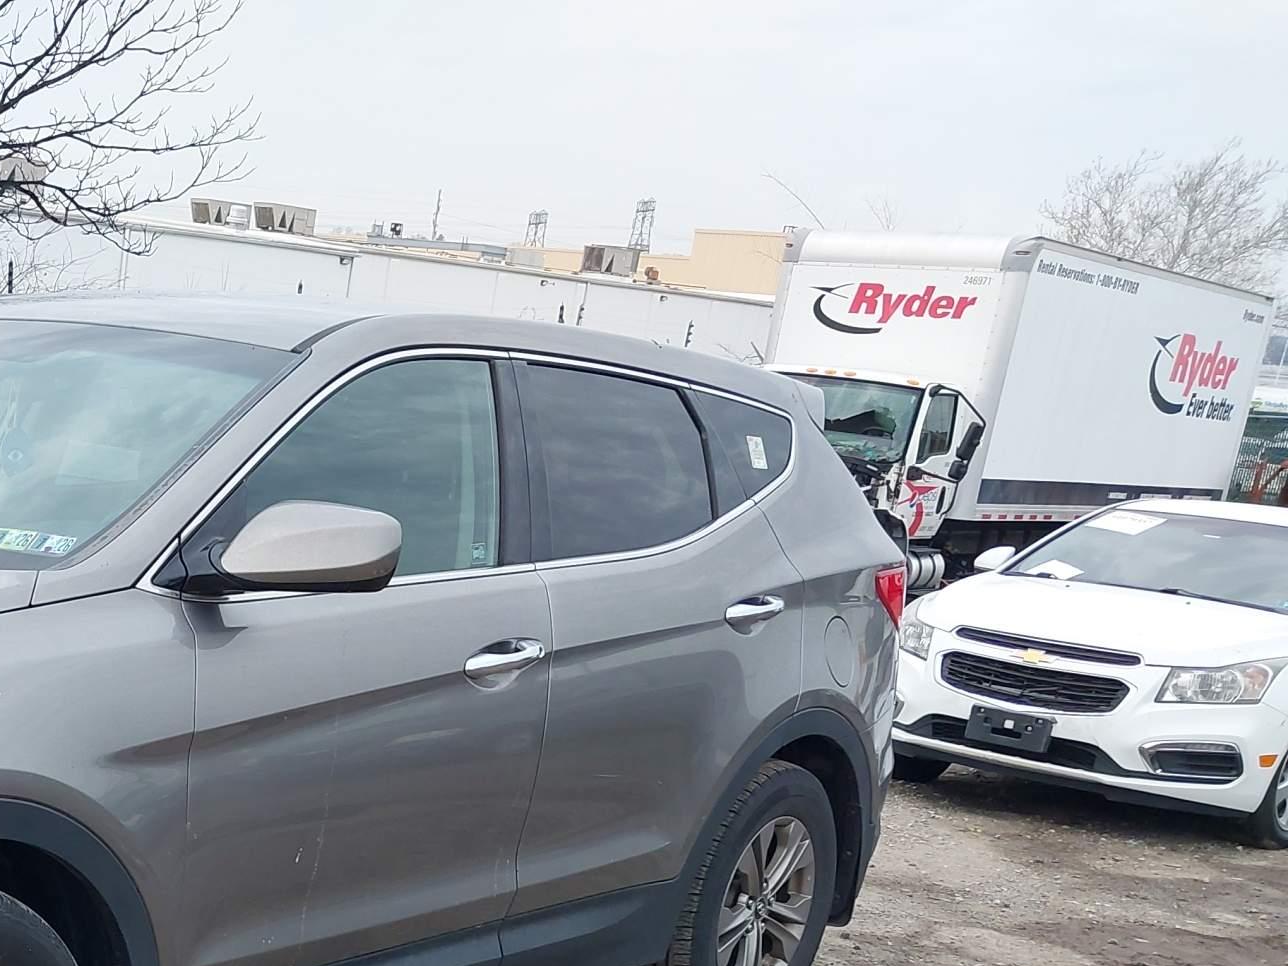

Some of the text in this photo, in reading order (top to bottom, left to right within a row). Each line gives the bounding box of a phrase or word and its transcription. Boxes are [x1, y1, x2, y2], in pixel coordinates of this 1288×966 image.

[1037, 259, 1058, 275] Rental
[963, 275, 992, 286] 246971
[848, 282, 978, 324] Ryder
[1169, 333, 1239, 397] Ryder
[1185, 393, 1209, 418] Ever
